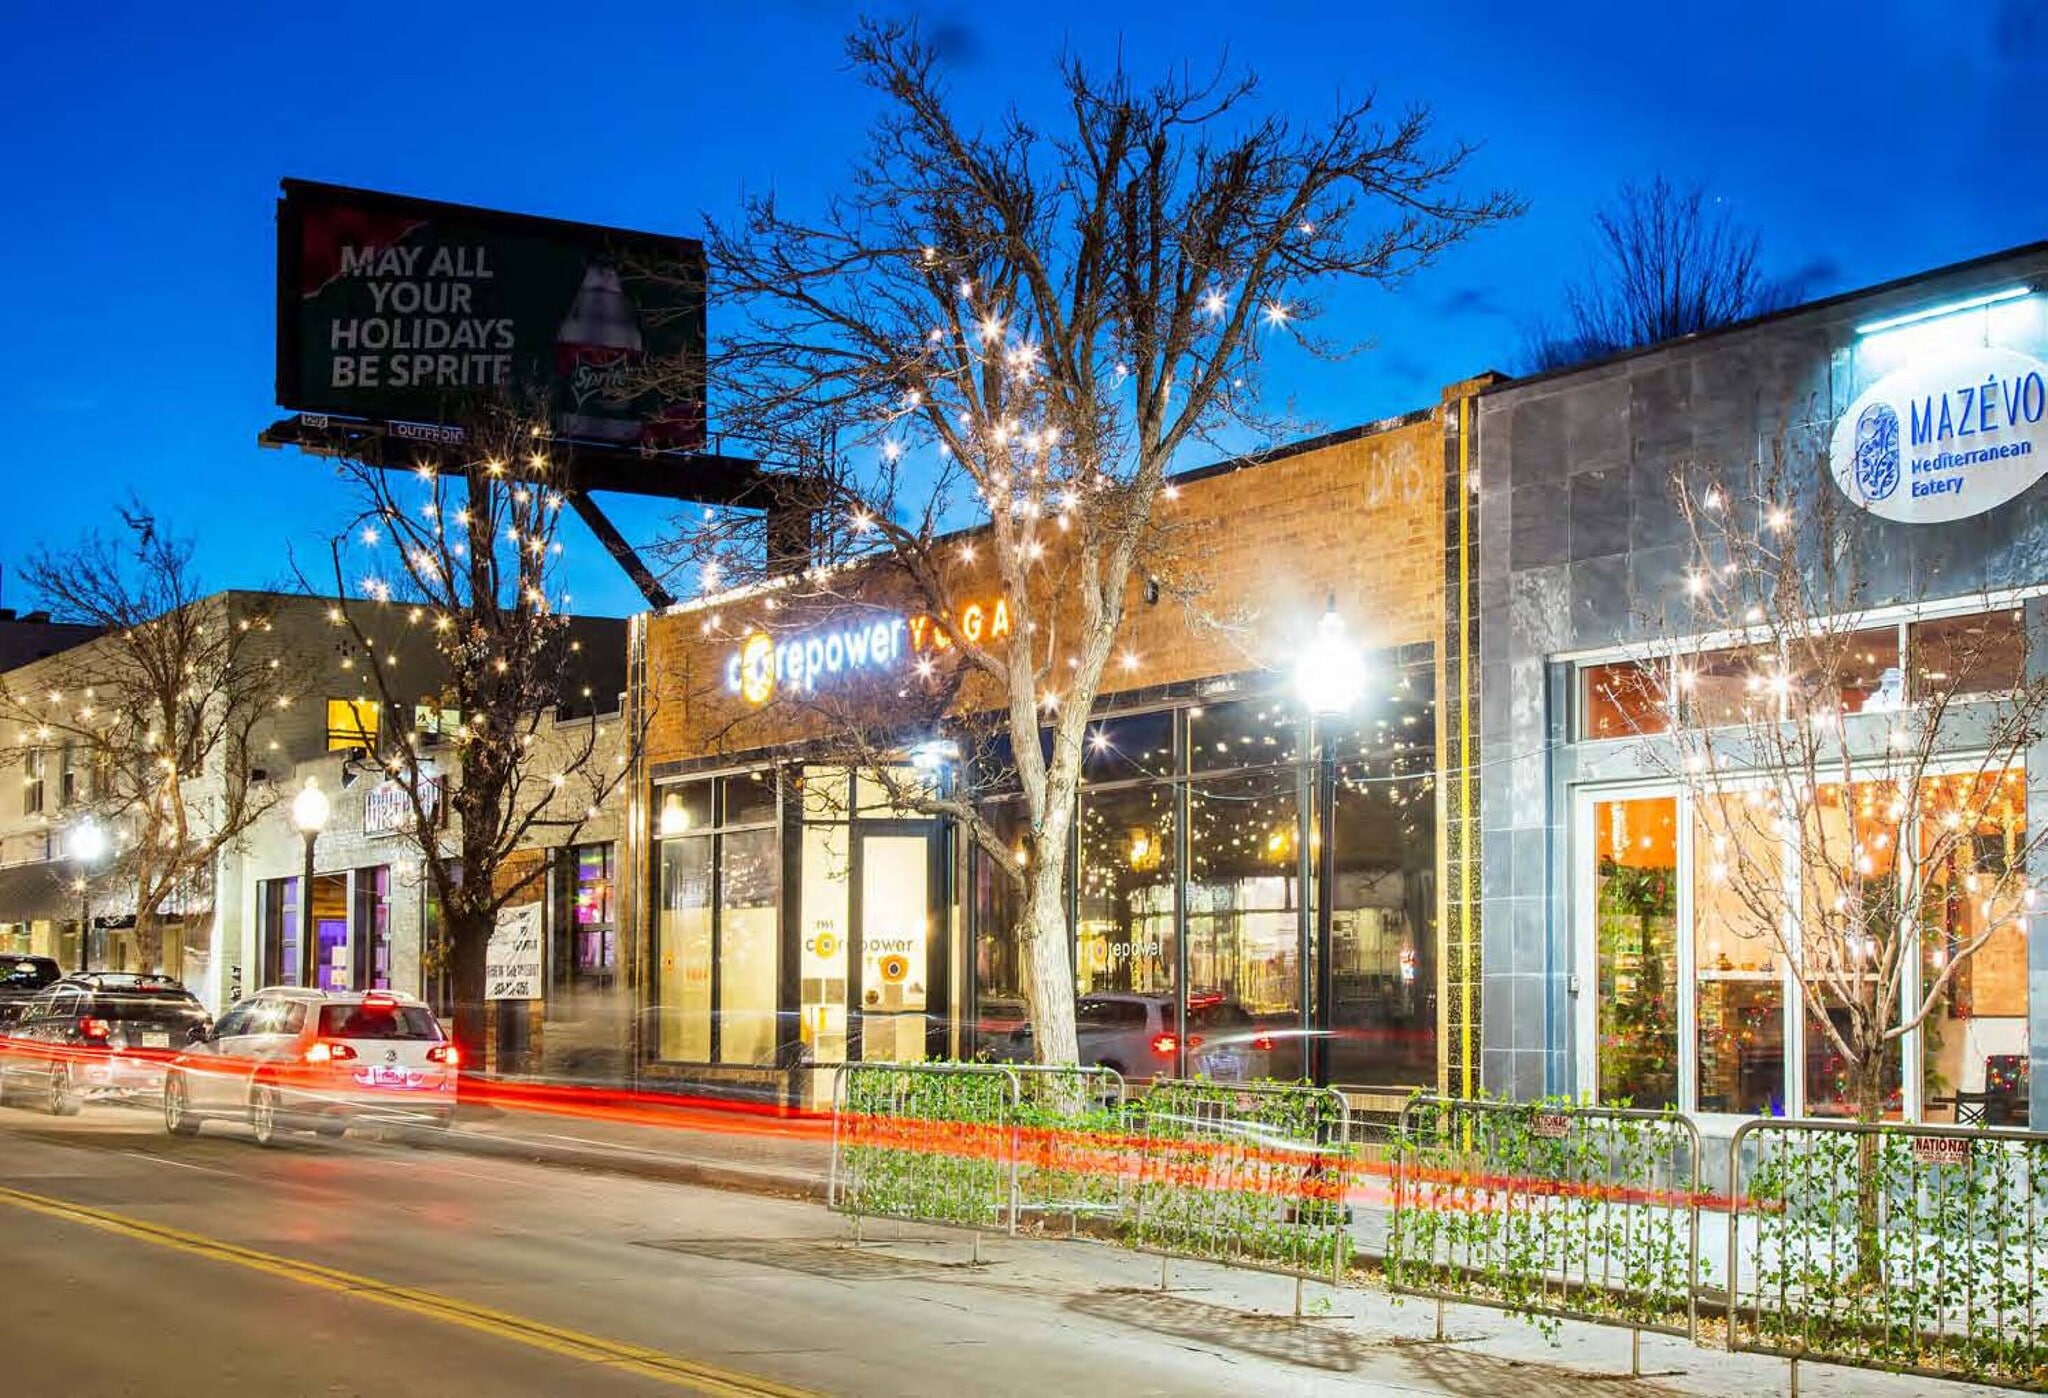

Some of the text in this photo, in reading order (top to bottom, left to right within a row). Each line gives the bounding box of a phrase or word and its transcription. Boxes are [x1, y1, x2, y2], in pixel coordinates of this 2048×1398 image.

[341, 245, 494, 278] MAY ALL
[368, 281, 473, 314] YOUR
[331, 317, 515, 350] HOLIDAYS
[331, 354, 513, 388] BE SPRITE
[1911, 371, 2046, 446] MAZÉVO
[1912, 440, 2032, 474] Mediterranean
[1912, 477, 1964, 498] Eatery
